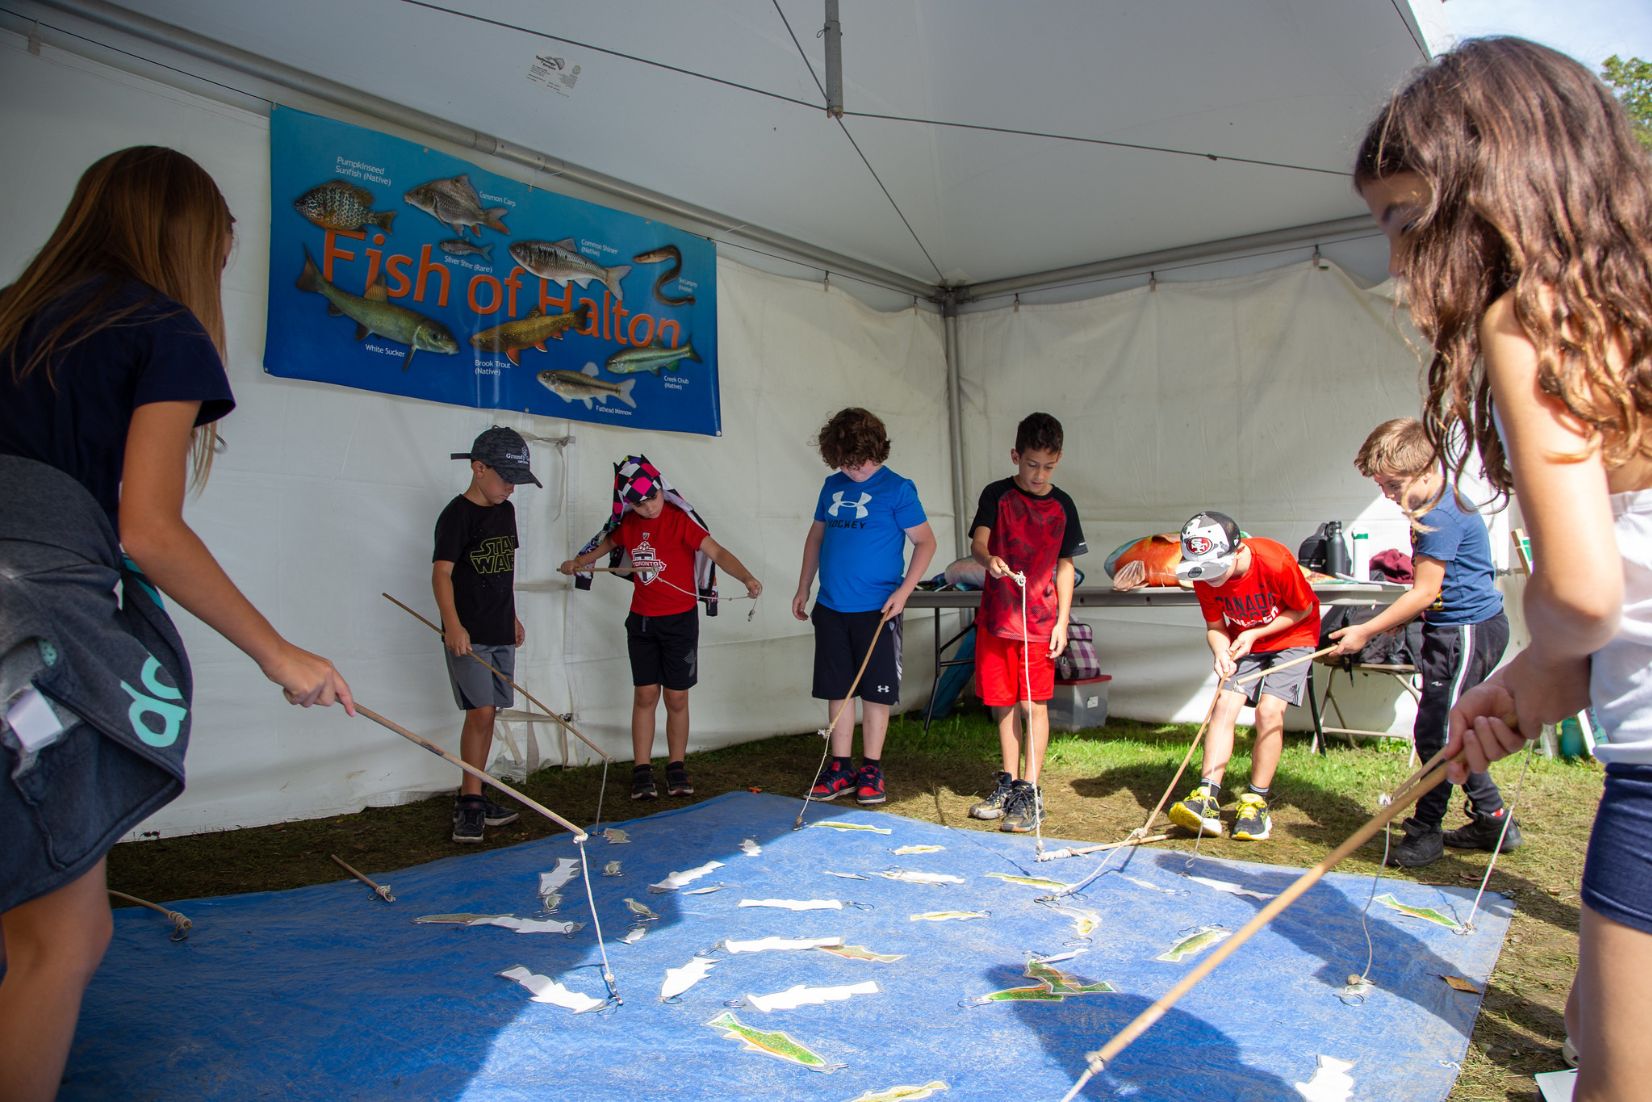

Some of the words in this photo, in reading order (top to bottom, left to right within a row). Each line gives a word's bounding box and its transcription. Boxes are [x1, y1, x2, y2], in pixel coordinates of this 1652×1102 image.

[336, 156, 385, 175] Pumpkinseed
[335, 165, 362, 180] Sunfish
[363, 171, 392, 187] (Native)
[323, 229, 450, 307] Fish
[474, 264, 493, 273] (Rare)
[468, 265, 525, 318] of
[539, 276, 681, 349] Halton
[365, 343, 384, 354] White
[385, 346, 405, 358] Sucker
[474, 359, 493, 368] Brook
[494, 360, 511, 369] Trout
[474, 367, 501, 376] (Native)
[663, 375, 677, 384] Creek
[827, 520, 866, 529] HOCKEY
